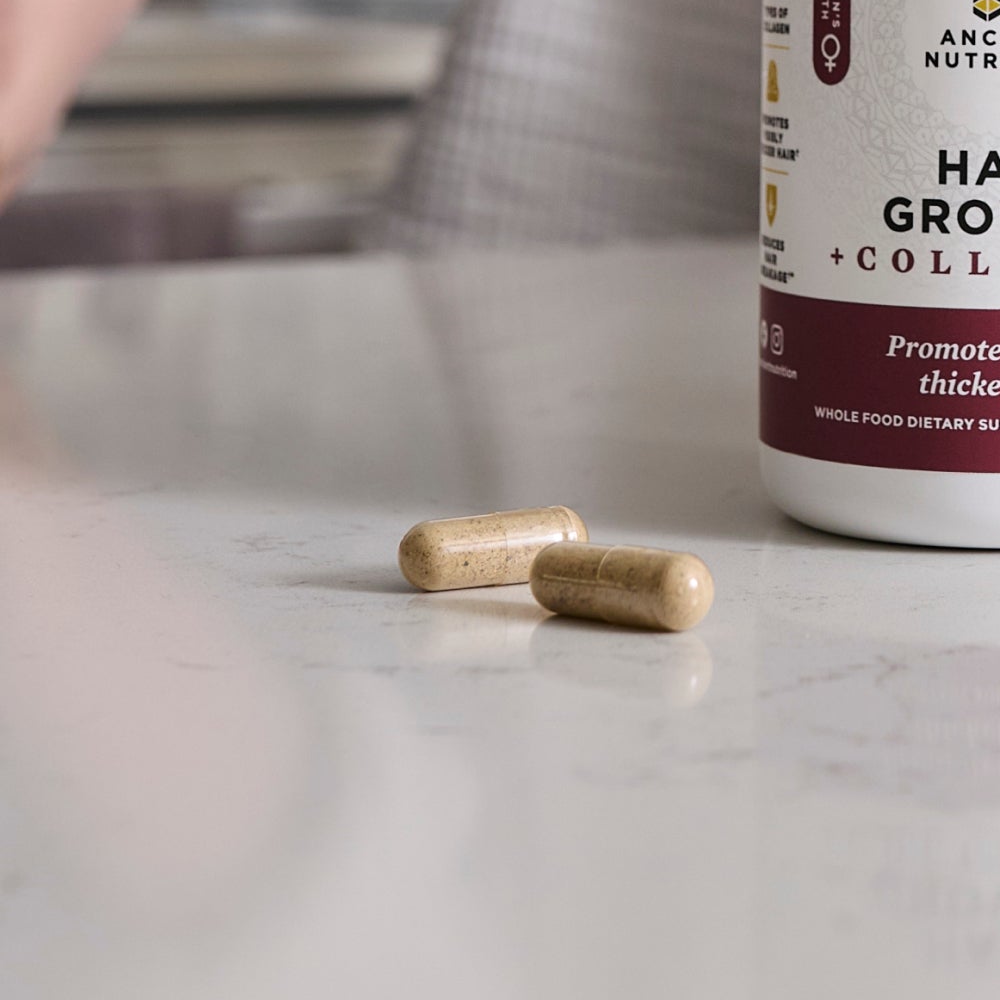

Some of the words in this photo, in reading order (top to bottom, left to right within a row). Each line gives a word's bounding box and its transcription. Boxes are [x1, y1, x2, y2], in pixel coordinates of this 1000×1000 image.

[814, 406, 859, 423] WHOLE
[862, 412, 903, 427] FOOD
[907, 416, 974, 430] DIETARY
